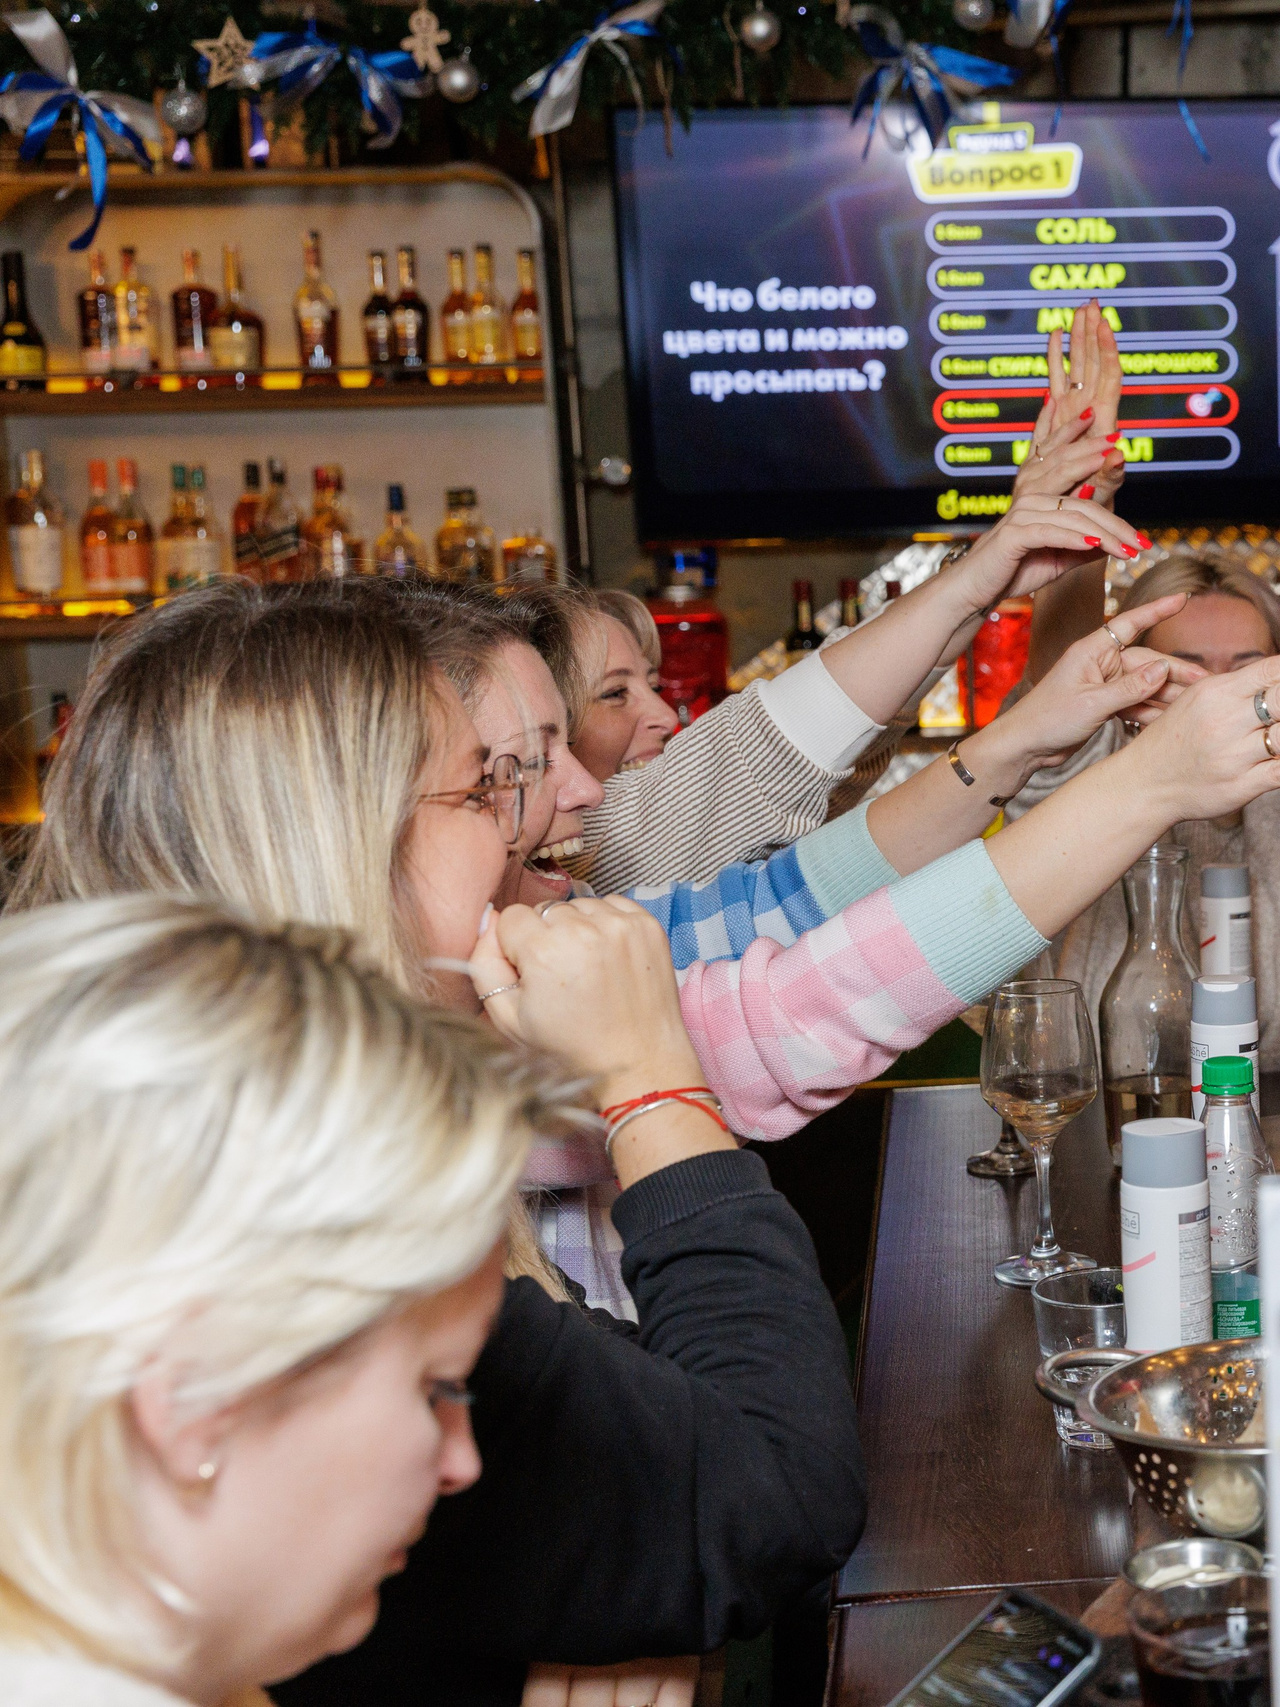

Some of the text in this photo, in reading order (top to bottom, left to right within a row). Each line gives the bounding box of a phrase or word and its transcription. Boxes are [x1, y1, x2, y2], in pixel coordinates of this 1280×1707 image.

[928, 160, 1063, 189] Вопрос 1
[1036, 217, 1116, 244] СОЛЬ
[1029, 263, 1126, 290] САХАР
[690, 277, 876, 312] Что белого
[663, 325, 908, 358] цвета и можно
[690, 359, 886, 402] просыпать?
